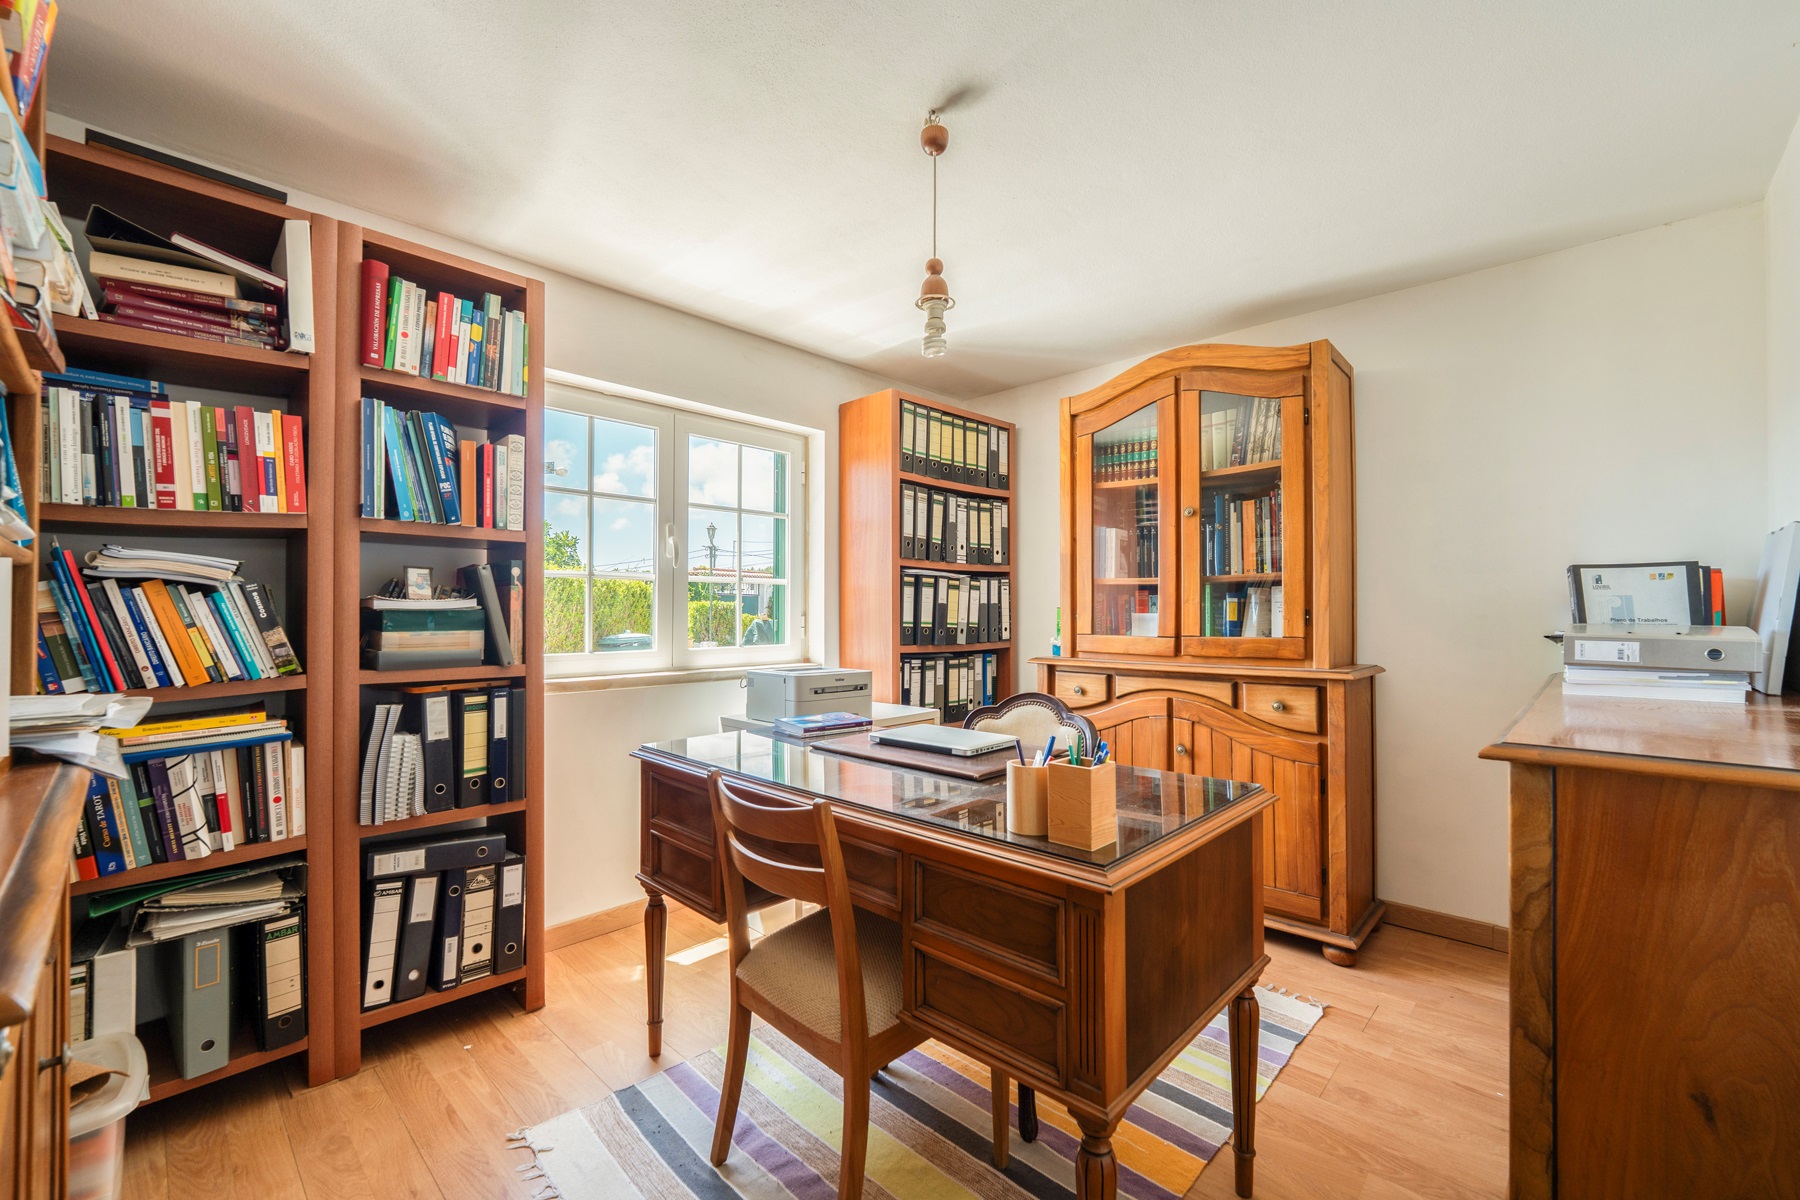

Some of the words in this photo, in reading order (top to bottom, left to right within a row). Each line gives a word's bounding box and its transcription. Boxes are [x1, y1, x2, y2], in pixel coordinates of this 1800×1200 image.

[70, 463, 78, 493] Conversando
[251, 590, 267, 618] Cosmos
[119, 614, 133, 638] BANCÁRIO
[129, 636, 140, 654] DIREITO
[139, 630, 153, 651] BANCÁRIO
[148, 649, 159, 665] DIREITO
[92, 794, 105, 820] TAROT
[98, 820, 107, 828] de
[100, 828, 111, 847] Curso
[267, 926, 298, 940] AMBAR
